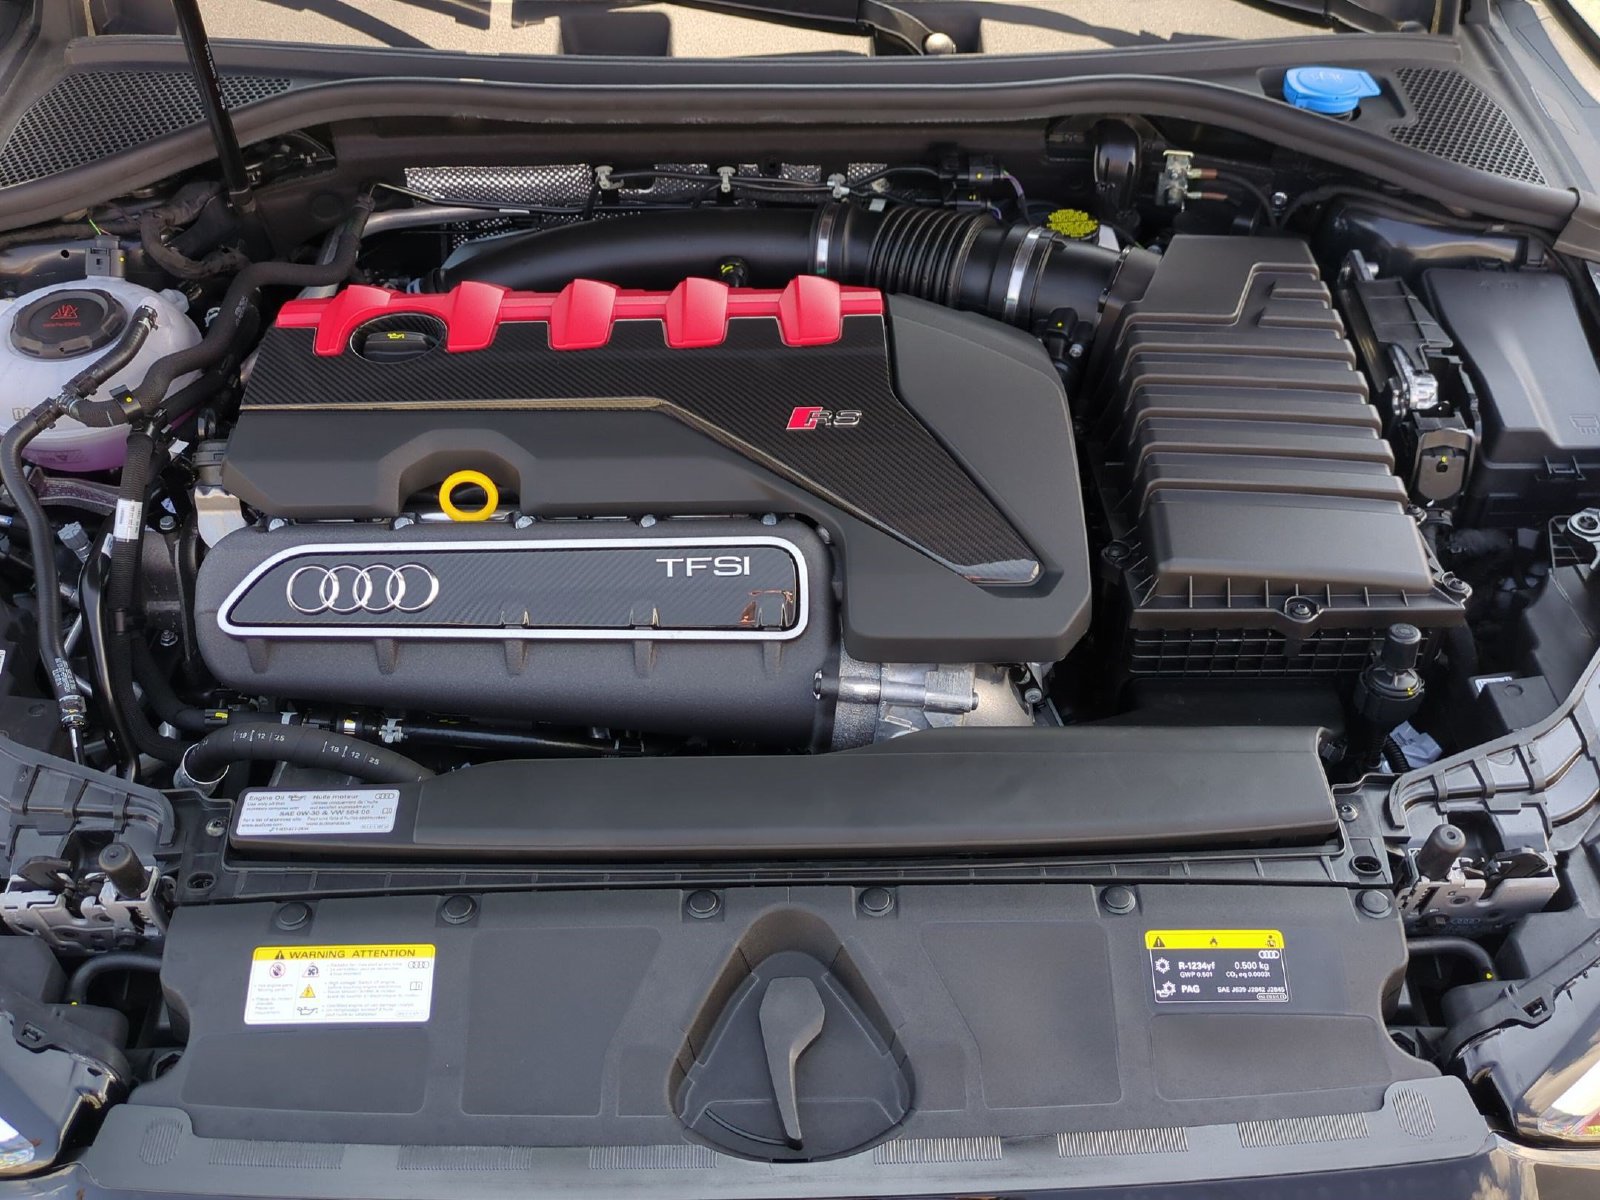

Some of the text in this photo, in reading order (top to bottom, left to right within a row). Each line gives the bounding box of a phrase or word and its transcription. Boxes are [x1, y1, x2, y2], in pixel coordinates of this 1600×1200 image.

[803, 409, 862, 428] RS
[655, 556, 750, 578] TFSI
[257, 732, 266, 740] 12
[274, 734, 285, 742] 25
[330, 744, 380, 766] 19 12 25
[289, 949, 416, 959] WARNING ATTENTION
[1178, 961, 1216, 971] R-1234yf
[1234, 961, 1270, 971] 0.500 kg
[1181, 985, 1201, 994] PAG
